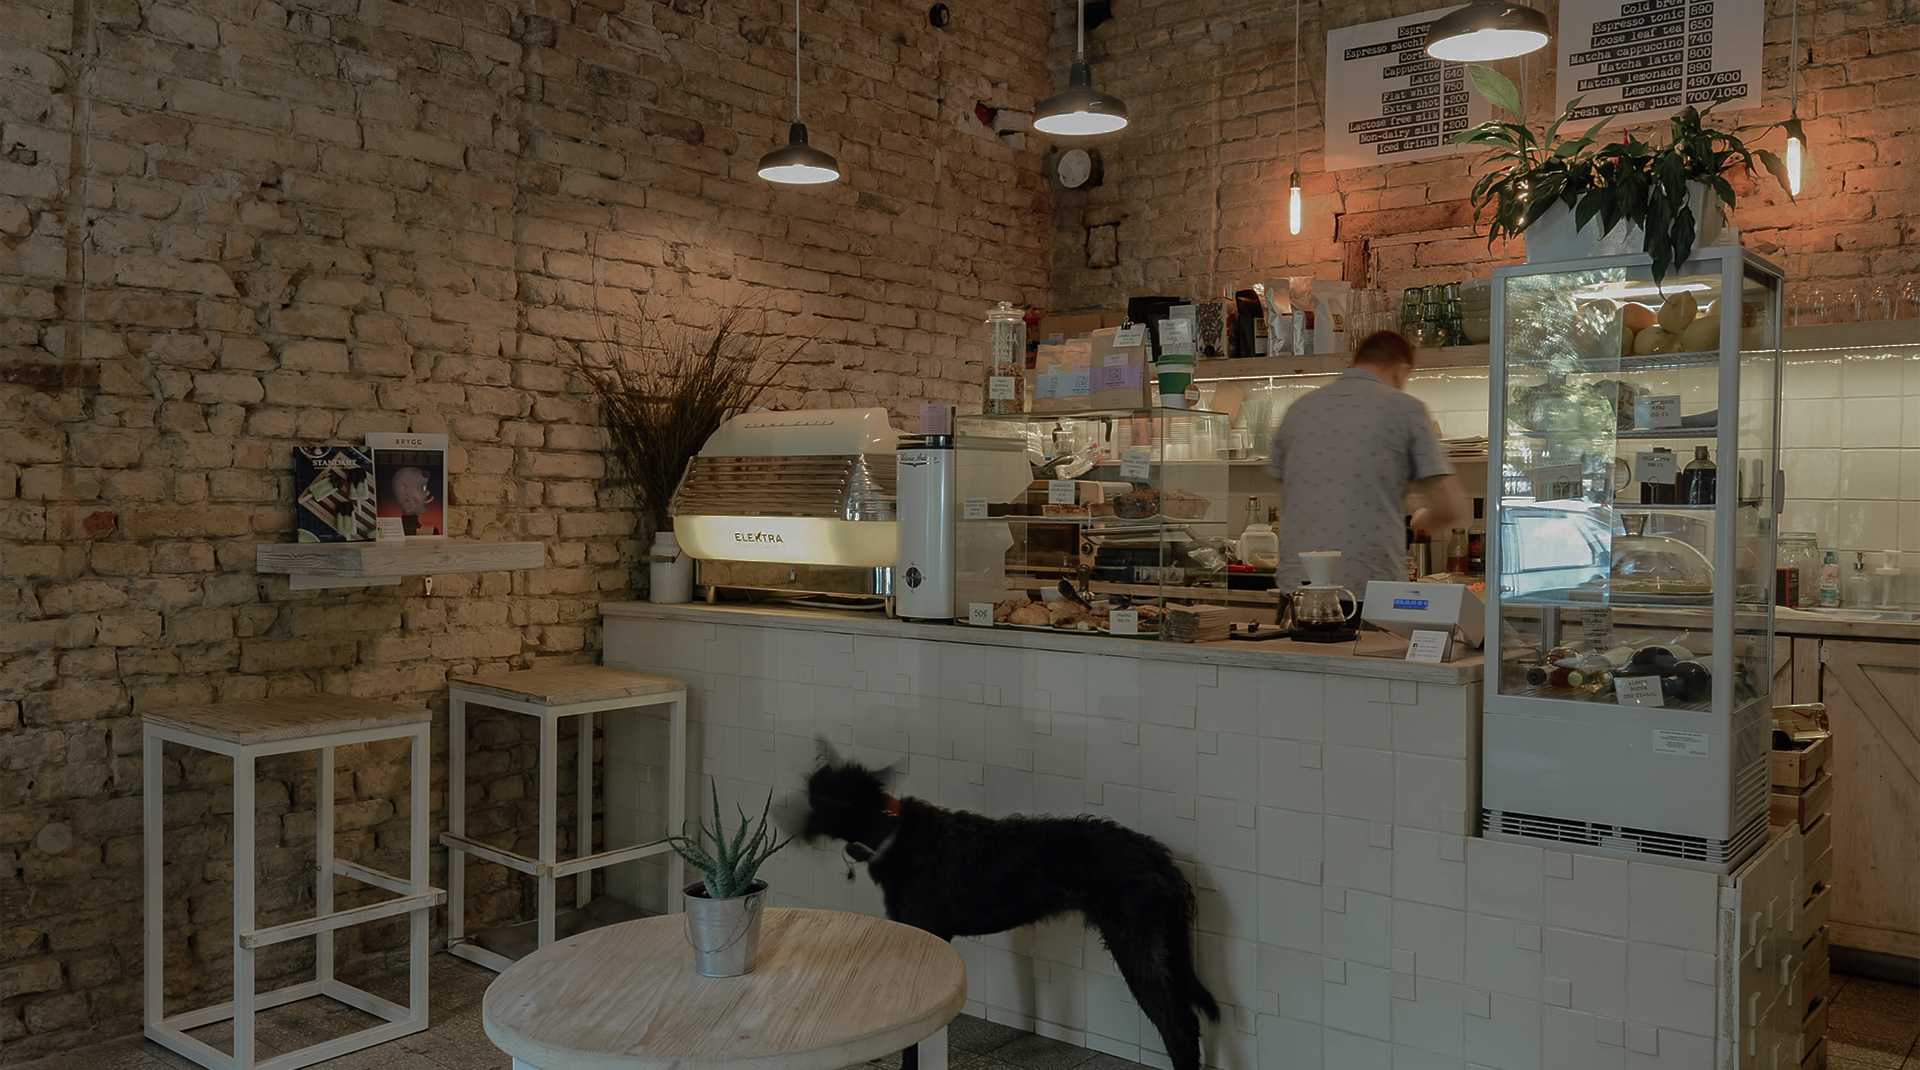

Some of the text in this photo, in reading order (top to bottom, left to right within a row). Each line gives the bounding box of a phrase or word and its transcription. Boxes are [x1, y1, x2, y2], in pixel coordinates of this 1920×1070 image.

[1623, 0, 1683, 15] Cold brew
[1594, 4, 1713, 33] Espresso tonic 890
[1399, 24, 1432, 36] Espres
[1593, 18, 1712, 47] Loose leaf tea 650
[1345, 45, 1388, 59] Espresso
[1571, 33, 1711, 65] Matcha cappuccino 740
[1384, 60, 1440, 77] Cappuccino
[1600, 47, 1711, 74] Matcha latte 800
[1411, 69, 1463, 85] Latte 640
[1580, 62, 1710, 90] Matcha lemonade 890
[1624, 72, 1740, 97] Lemonade 490/600
[1383, 82, 1463, 102] Flat white 750
[1604, 101, 1645, 114] orange
[1650, 94, 1681, 109] juice
[1688, 85, 1746, 102] 700/1050
[1384, 93, 1468, 114] Extra shot +200
[1349, 105, 1467, 132] Lactose free milk +150
[1360, 119, 1467, 143] Non-dairy milk +200
[1379, 142, 1400, 153] Iced
[1404, 137, 1438, 149] drinks
[395, 438, 423, 446] BRYGG
[312, 459, 358, 467] STANDART
[734, 531, 784, 544] ELEKTRA
